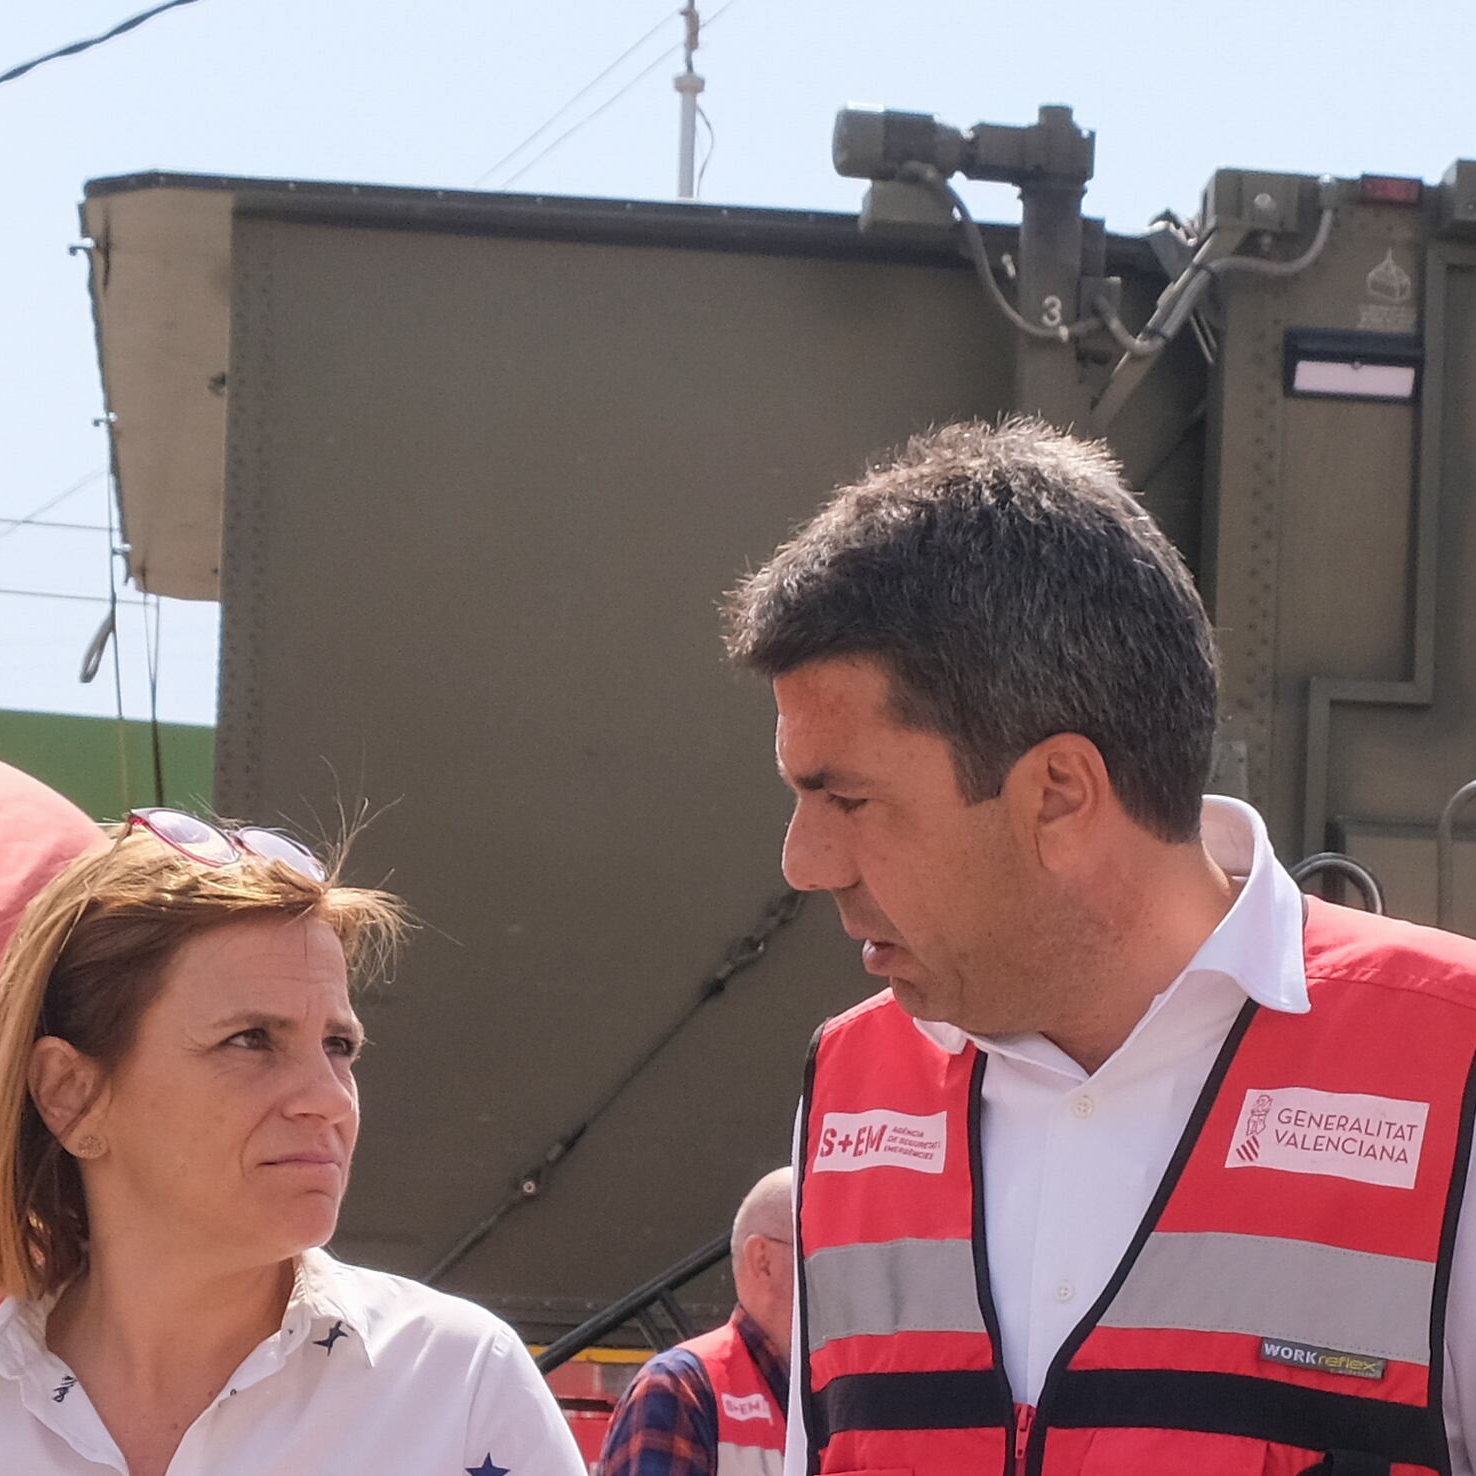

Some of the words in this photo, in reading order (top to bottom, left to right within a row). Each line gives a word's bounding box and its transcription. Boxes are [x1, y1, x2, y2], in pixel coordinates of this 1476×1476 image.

[1043, 295, 1062, 327] 3
[819, 1124, 888, 1157] S+EM
[1277, 1107, 1419, 1142] GENERALITAT
[1274, 1128, 1409, 1164] VALENCIANA
